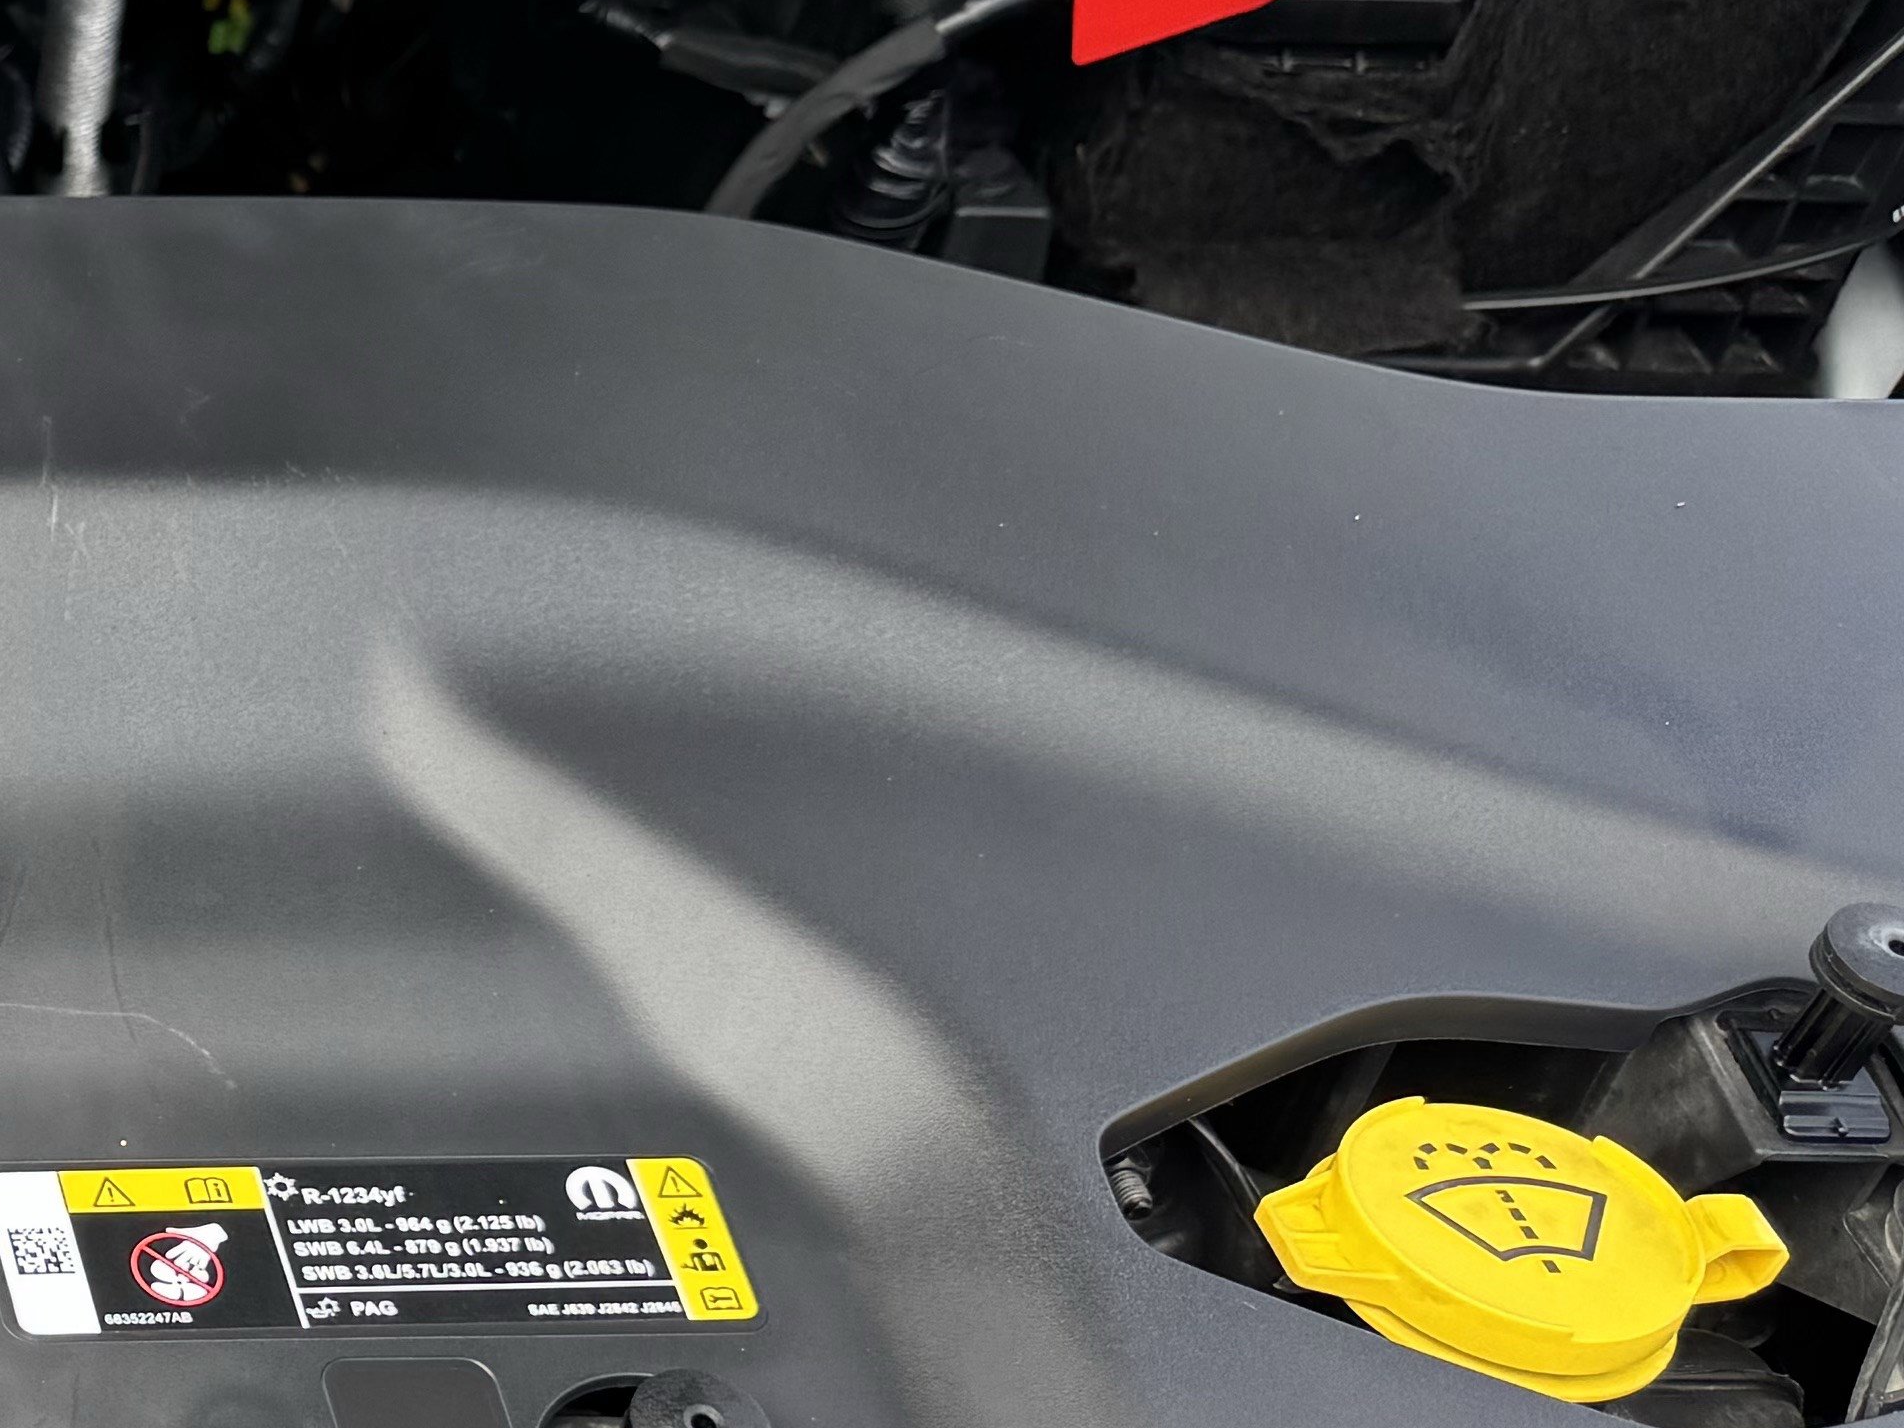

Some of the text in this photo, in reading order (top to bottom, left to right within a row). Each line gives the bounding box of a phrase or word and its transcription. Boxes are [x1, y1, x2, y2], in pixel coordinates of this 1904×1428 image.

[300, 1186, 406, 1207] R-1234yf
[287, 1218, 336, 1234] LWB
[337, 1217, 382, 1233] 3.0L
[395, 1217, 434, 1232] 964
[435, 1218, 452, 1234] g
[453, 1215, 515, 1233] (2.125
[515, 1214, 546, 1232] lb)
[293, 1241, 344, 1257] SWB
[346, 1240, 391, 1256] 6.4L
[444, 1241, 461, 1257] g
[462, 1237, 521, 1256] (1.937
[524, 1236, 555, 1254] lb)
[301, 1265, 353, 1281] SWB
[545, 1263, 563, 1279] g
[624, 1259, 655, 1277] lb)
[350, 1300, 398, 1317] PAG
[527, 1303, 560, 1316] SAE
